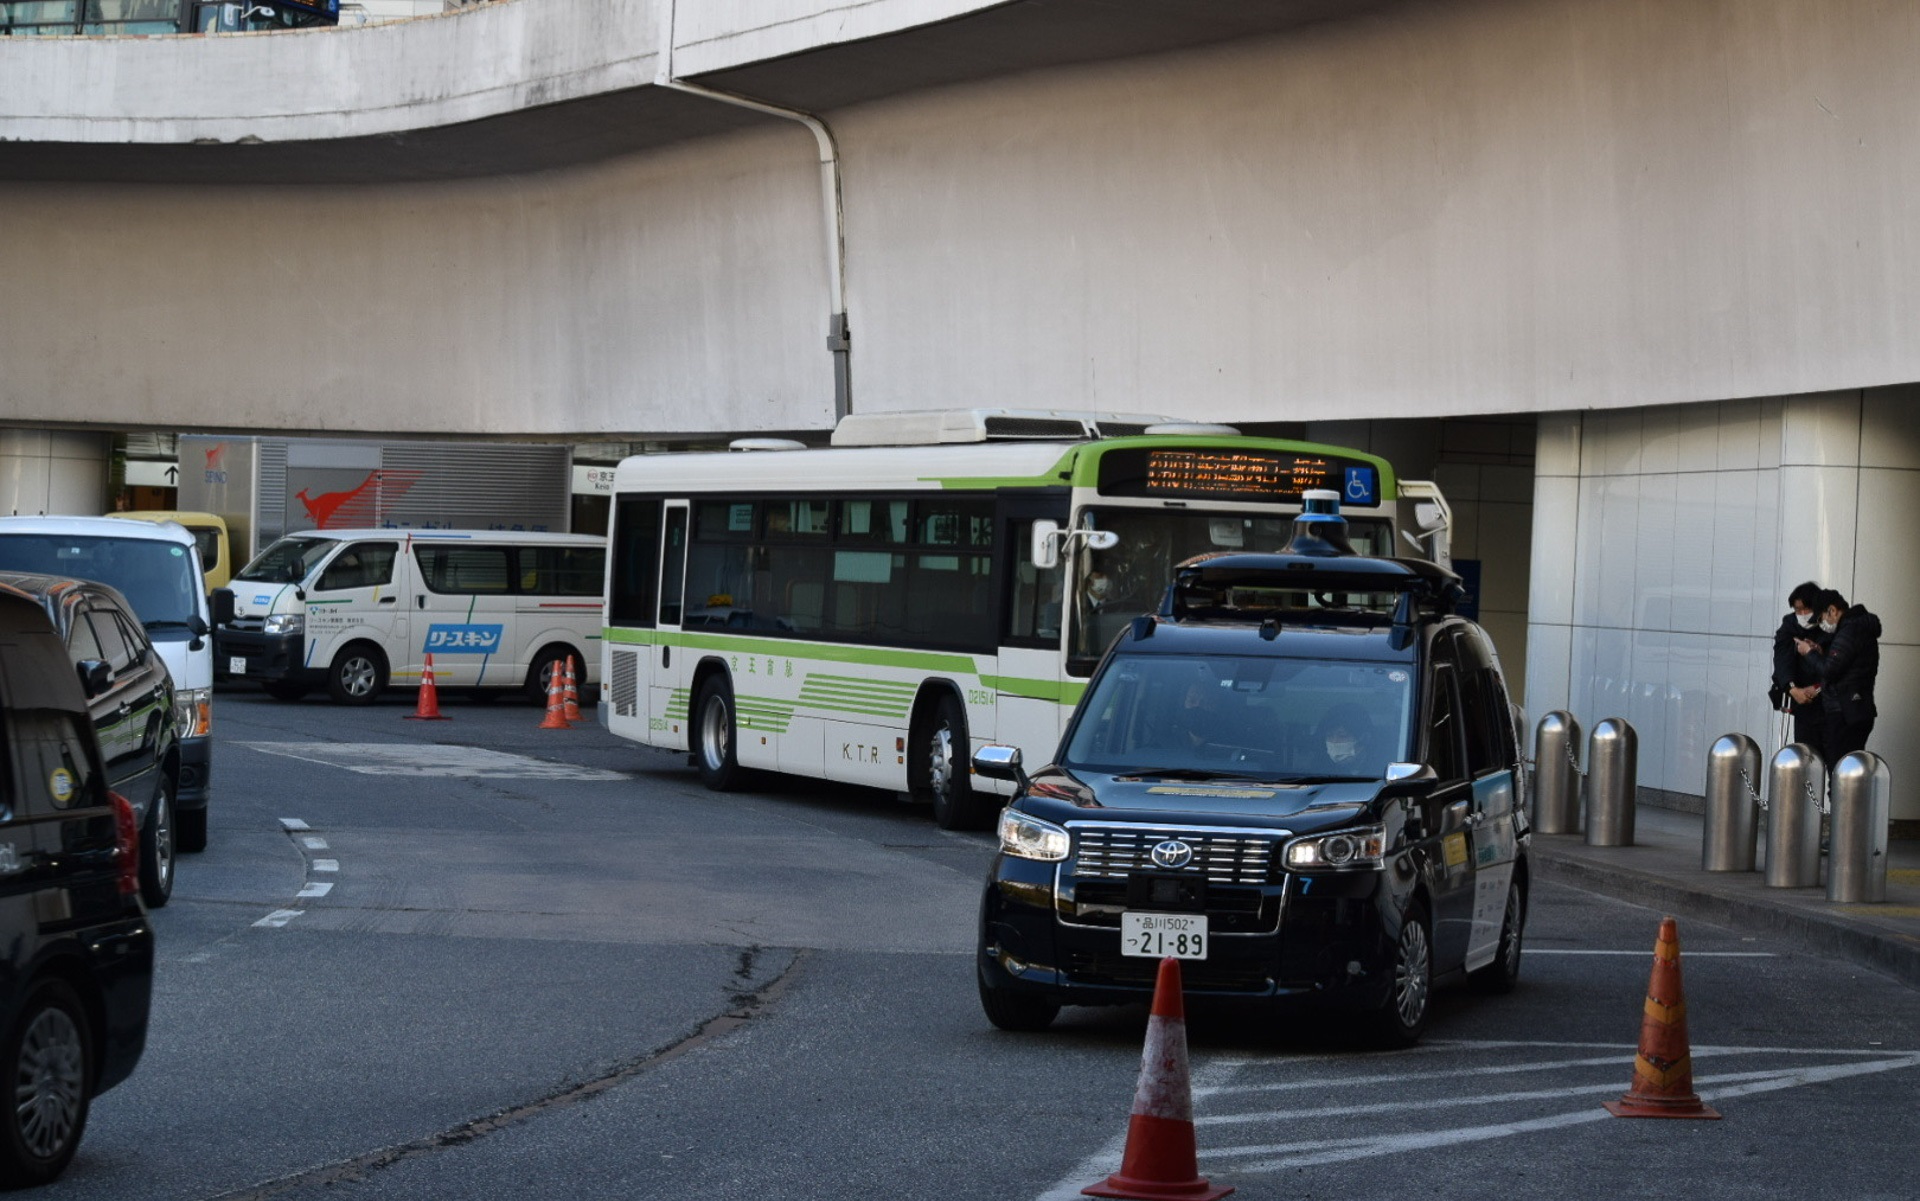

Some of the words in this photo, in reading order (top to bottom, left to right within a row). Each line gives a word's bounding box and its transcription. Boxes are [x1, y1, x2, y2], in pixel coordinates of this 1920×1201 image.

[429, 631, 497, 646] リースキン
[1300, 878, 1312, 895] 7
[1140, 931, 1202, 956] 21-89
